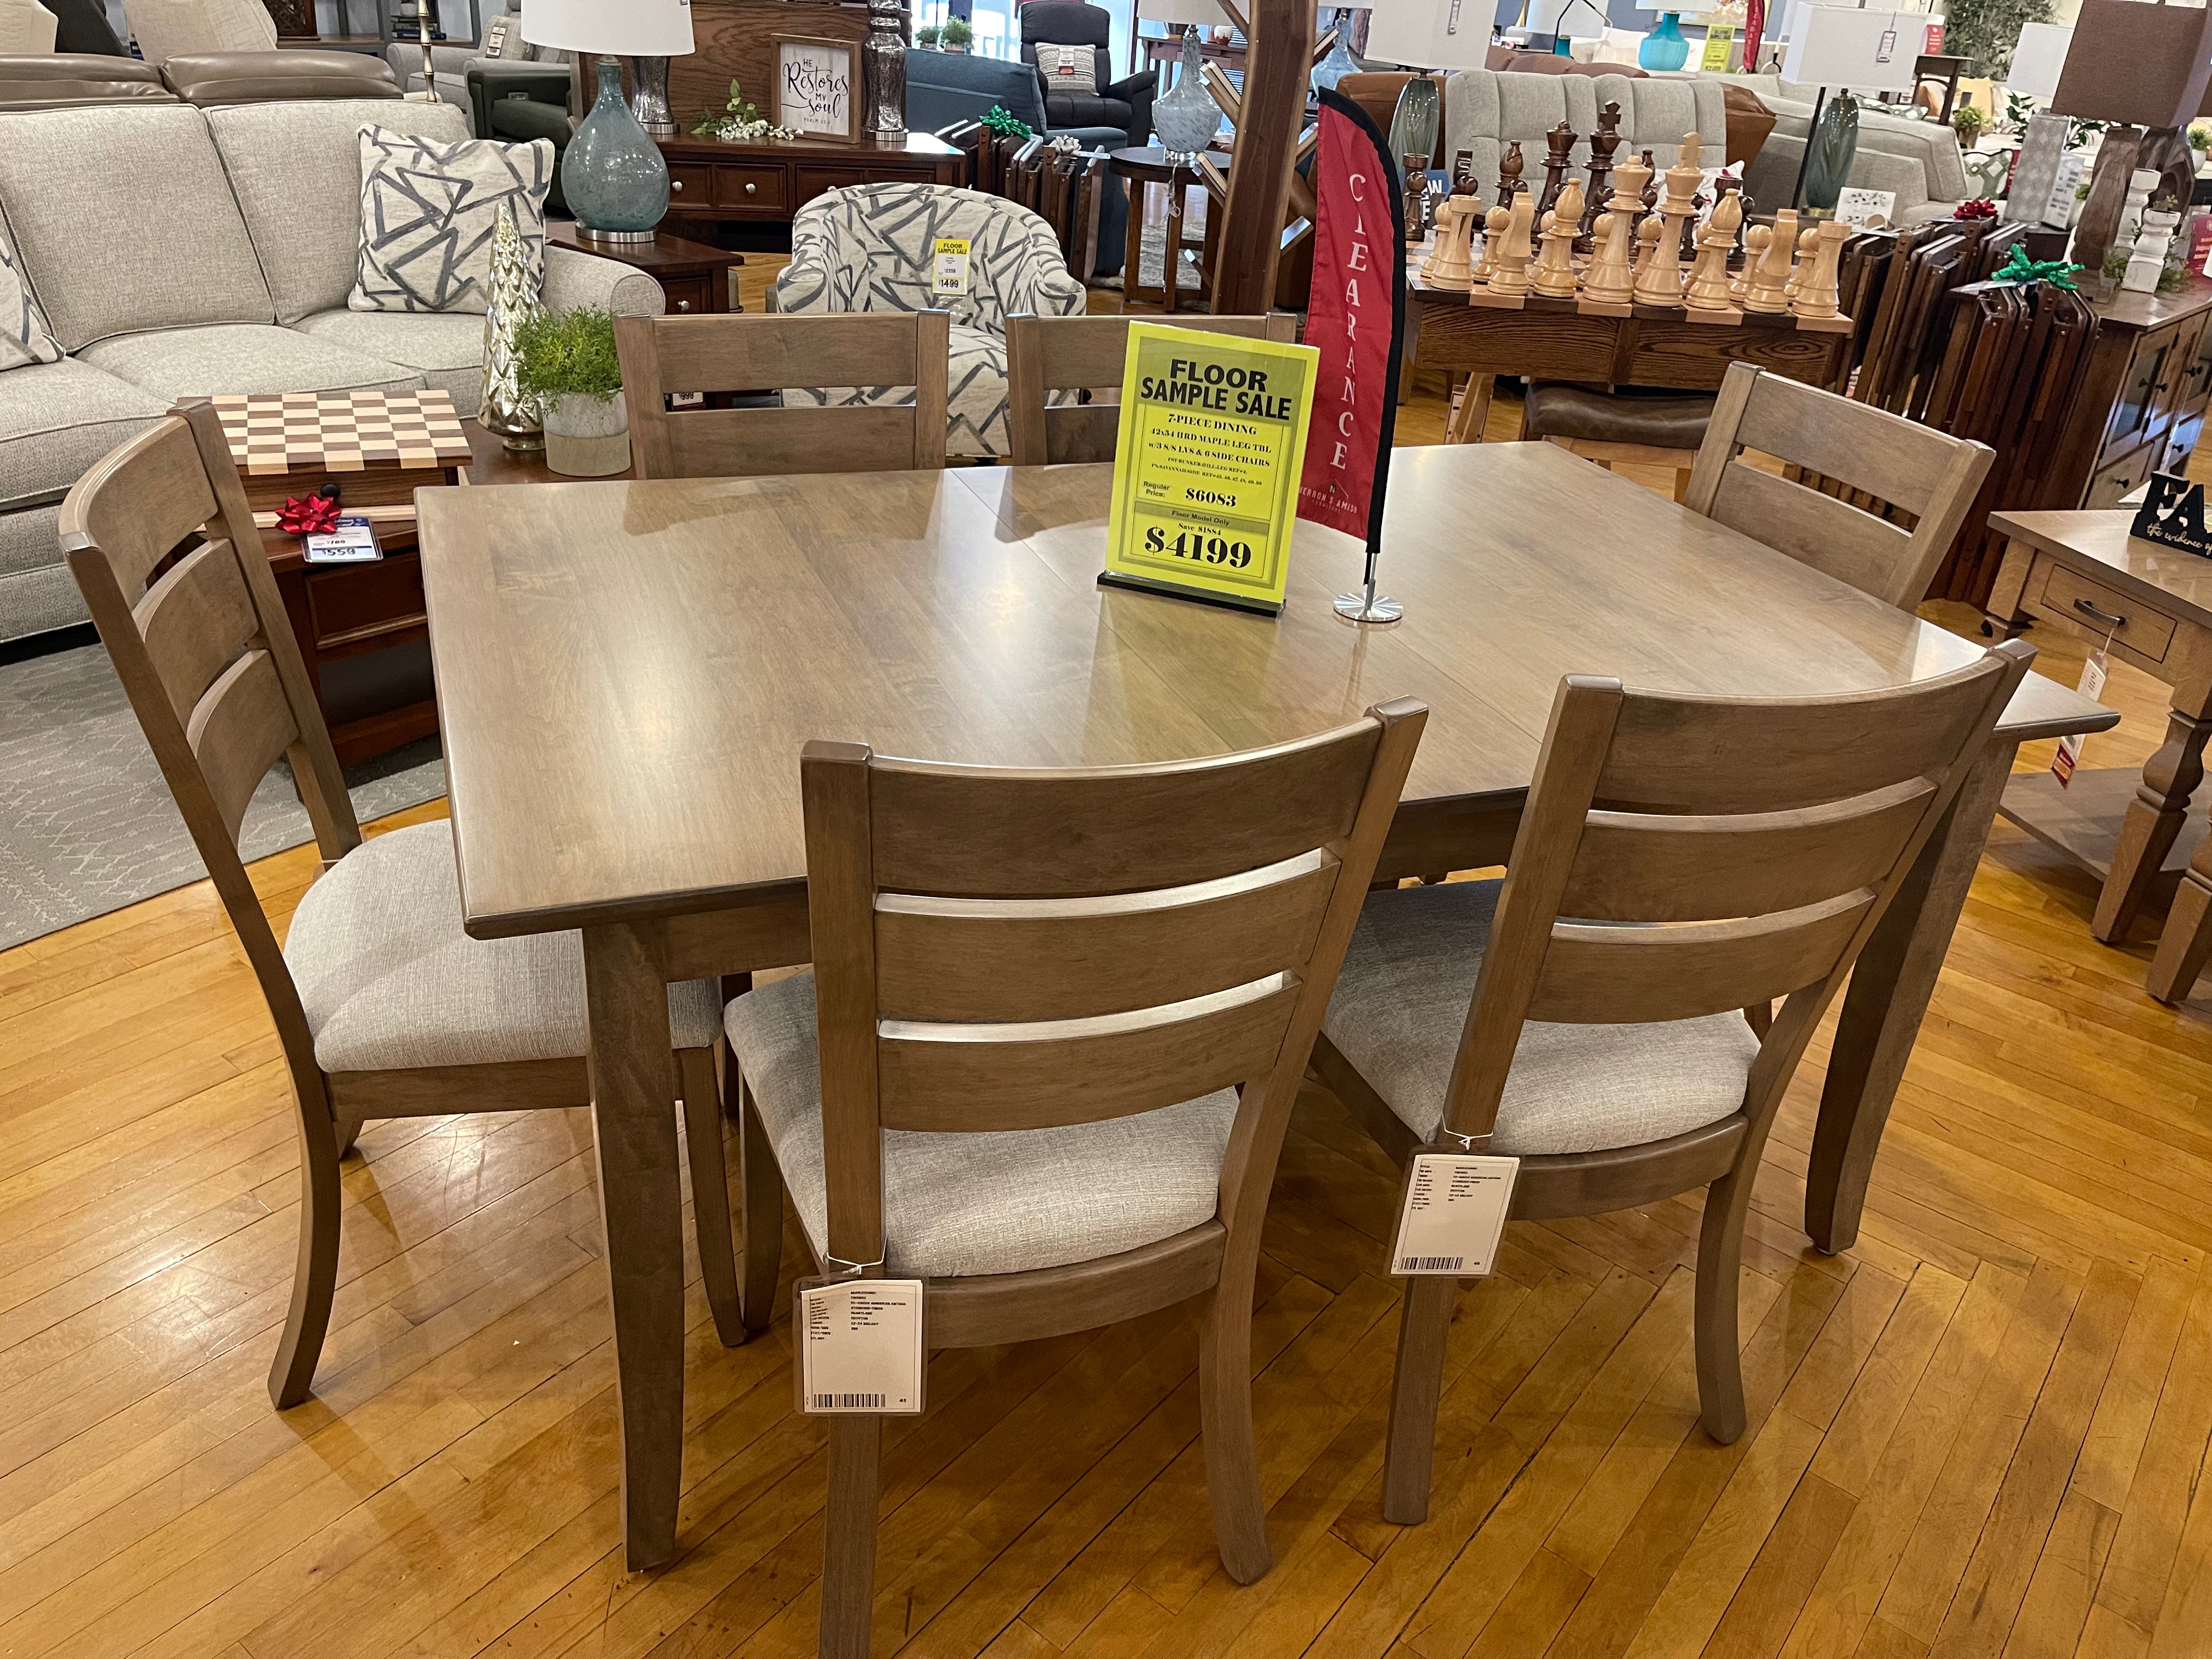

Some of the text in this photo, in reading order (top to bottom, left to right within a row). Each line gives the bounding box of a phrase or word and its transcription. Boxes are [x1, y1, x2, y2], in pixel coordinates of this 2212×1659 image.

[803, 58, 812, 67] HE
[783, 61, 848, 100] Restores
[815, 93, 826, 101] MY
[1170, 358, 1267, 393] FLOOR
[1141, 377, 1292, 420] SAMPLE SALE
[1168, 414, 1257, 436] 7-PIECE DINING
[1177, 432, 1197, 441] HRD
[1200, 436, 1230, 446] MAPLE
[1233, 441, 1251, 449] LEG
[1252, 444, 1272, 453] TBL
[1178, 446, 1194, 454] LVS
[1212, 452, 1234, 461] SIDE
[1235, 455, 1270, 466] CHAIRS
[1143, 481, 1236, 507] Regular $6083
[1146, 489, 1165, 498] Price:
[1172, 510, 1230, 526] Floor Model Only
[1178, 523, 1221, 535] Save $1884
[1144, 525, 1251, 568] $4199
